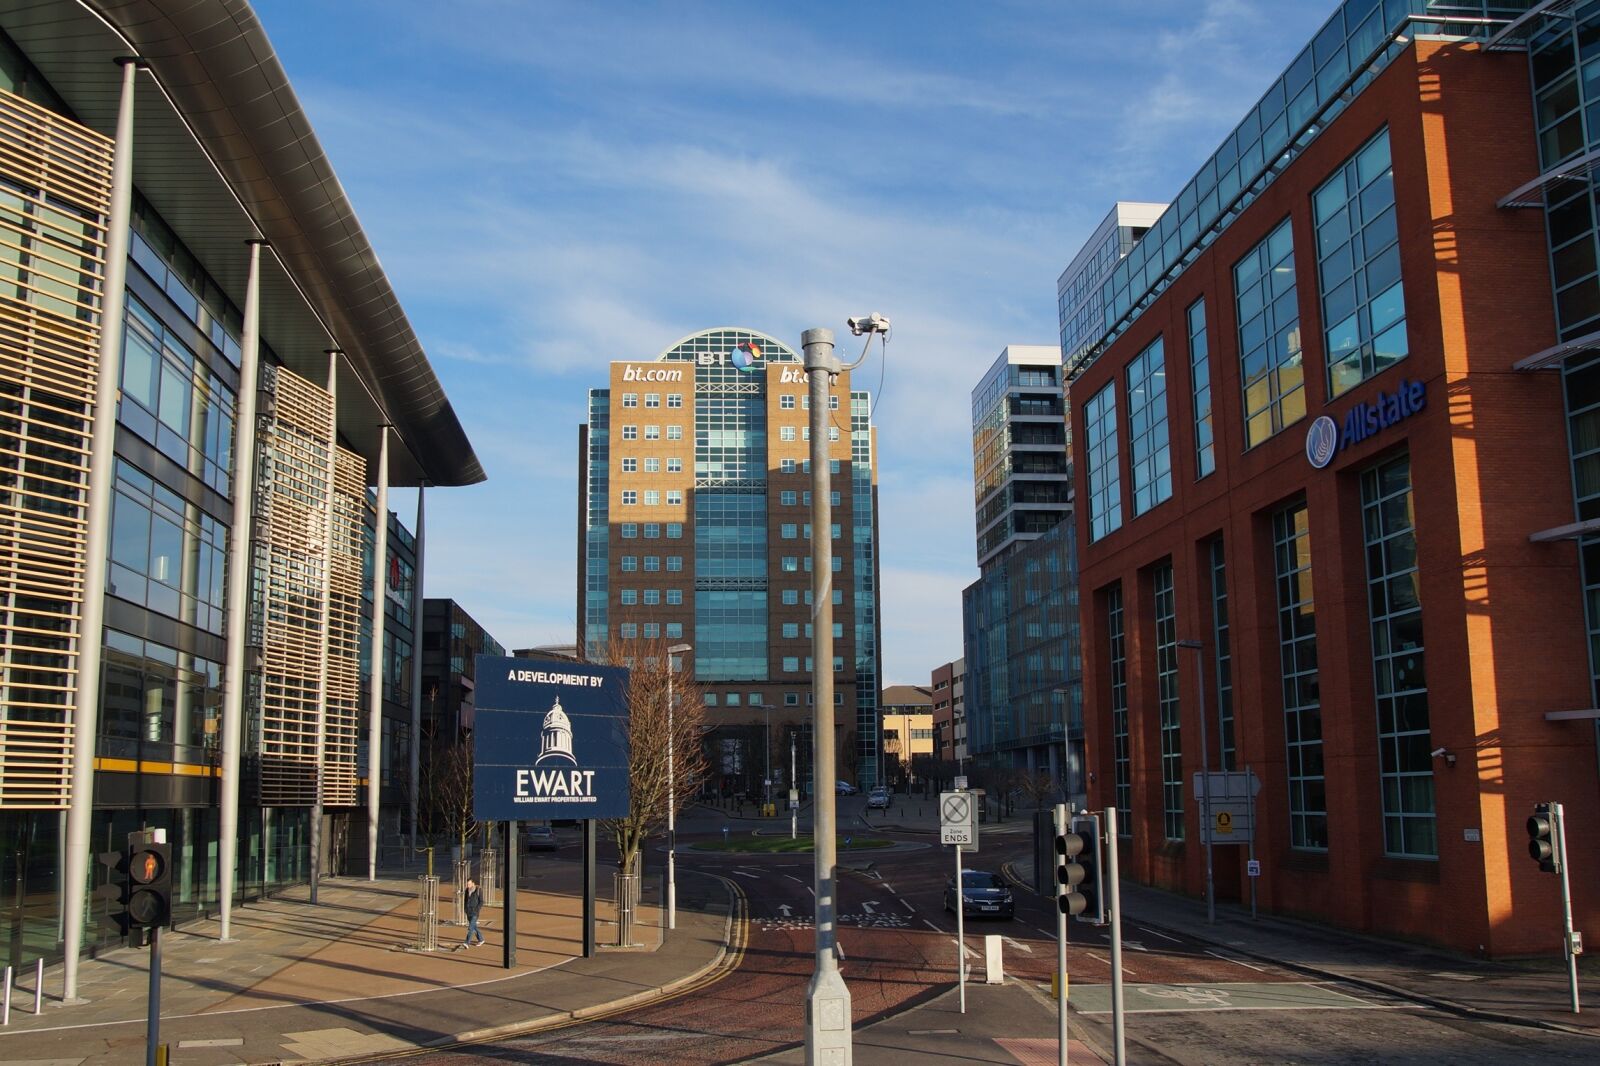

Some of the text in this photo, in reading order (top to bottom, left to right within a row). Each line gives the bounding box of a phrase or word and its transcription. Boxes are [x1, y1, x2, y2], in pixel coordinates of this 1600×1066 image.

[697, 351, 731, 365] BT
[622, 364, 683, 382] bt.com
[780, 366, 837, 384] bt.c
[1340, 379, 1427, 450] Allstate
[508, 670, 603, 687] A DEVELOPMENT BY
[516, 770, 595, 796] EWART
[945, 834, 968, 842] ENDS
